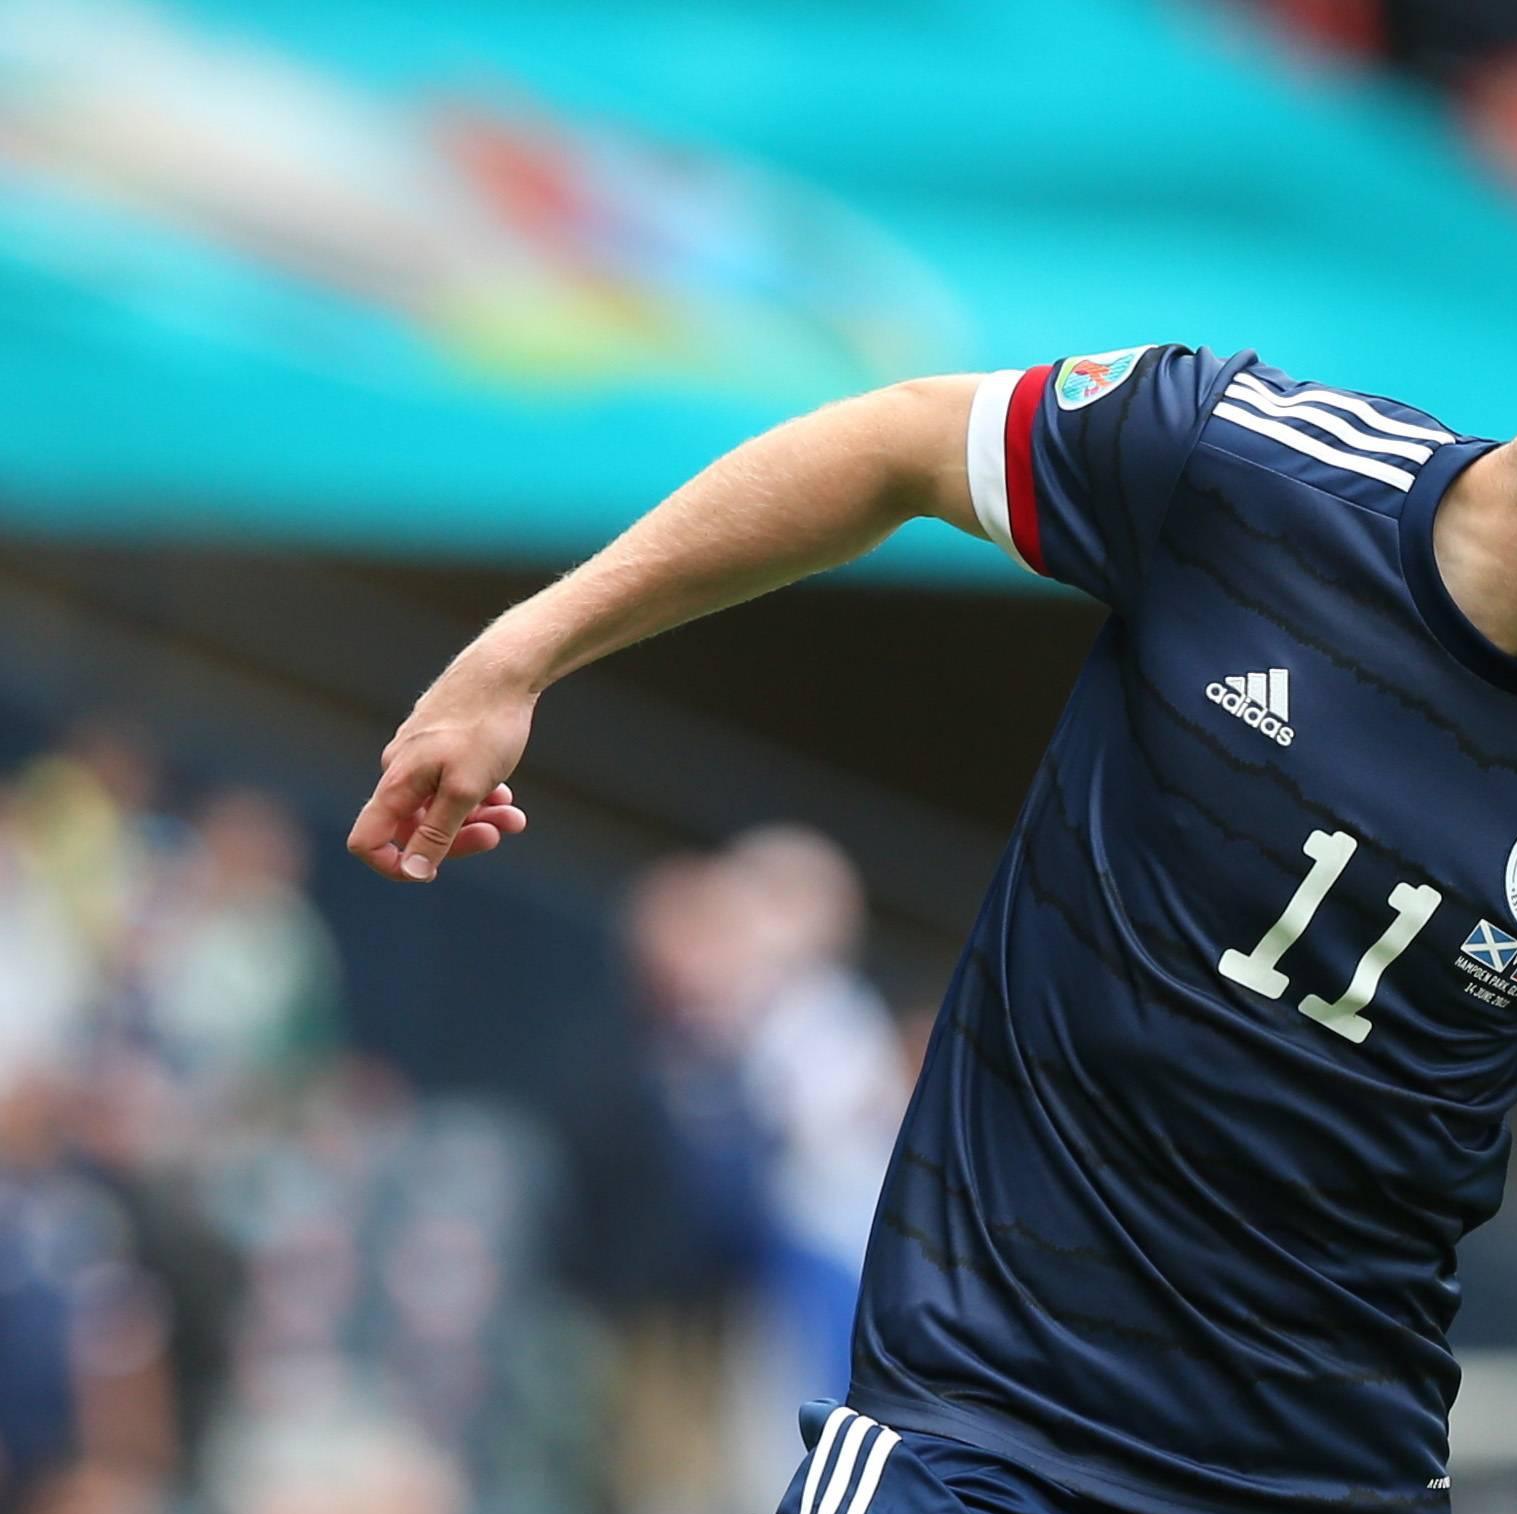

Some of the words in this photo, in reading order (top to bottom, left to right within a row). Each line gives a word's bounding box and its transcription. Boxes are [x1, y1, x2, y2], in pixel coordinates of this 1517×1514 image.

[1205, 682, 1295, 747] adidas
[1218, 829, 1442, 1044] 11
[1454, 956, 1492, 983] HAMPDEN
